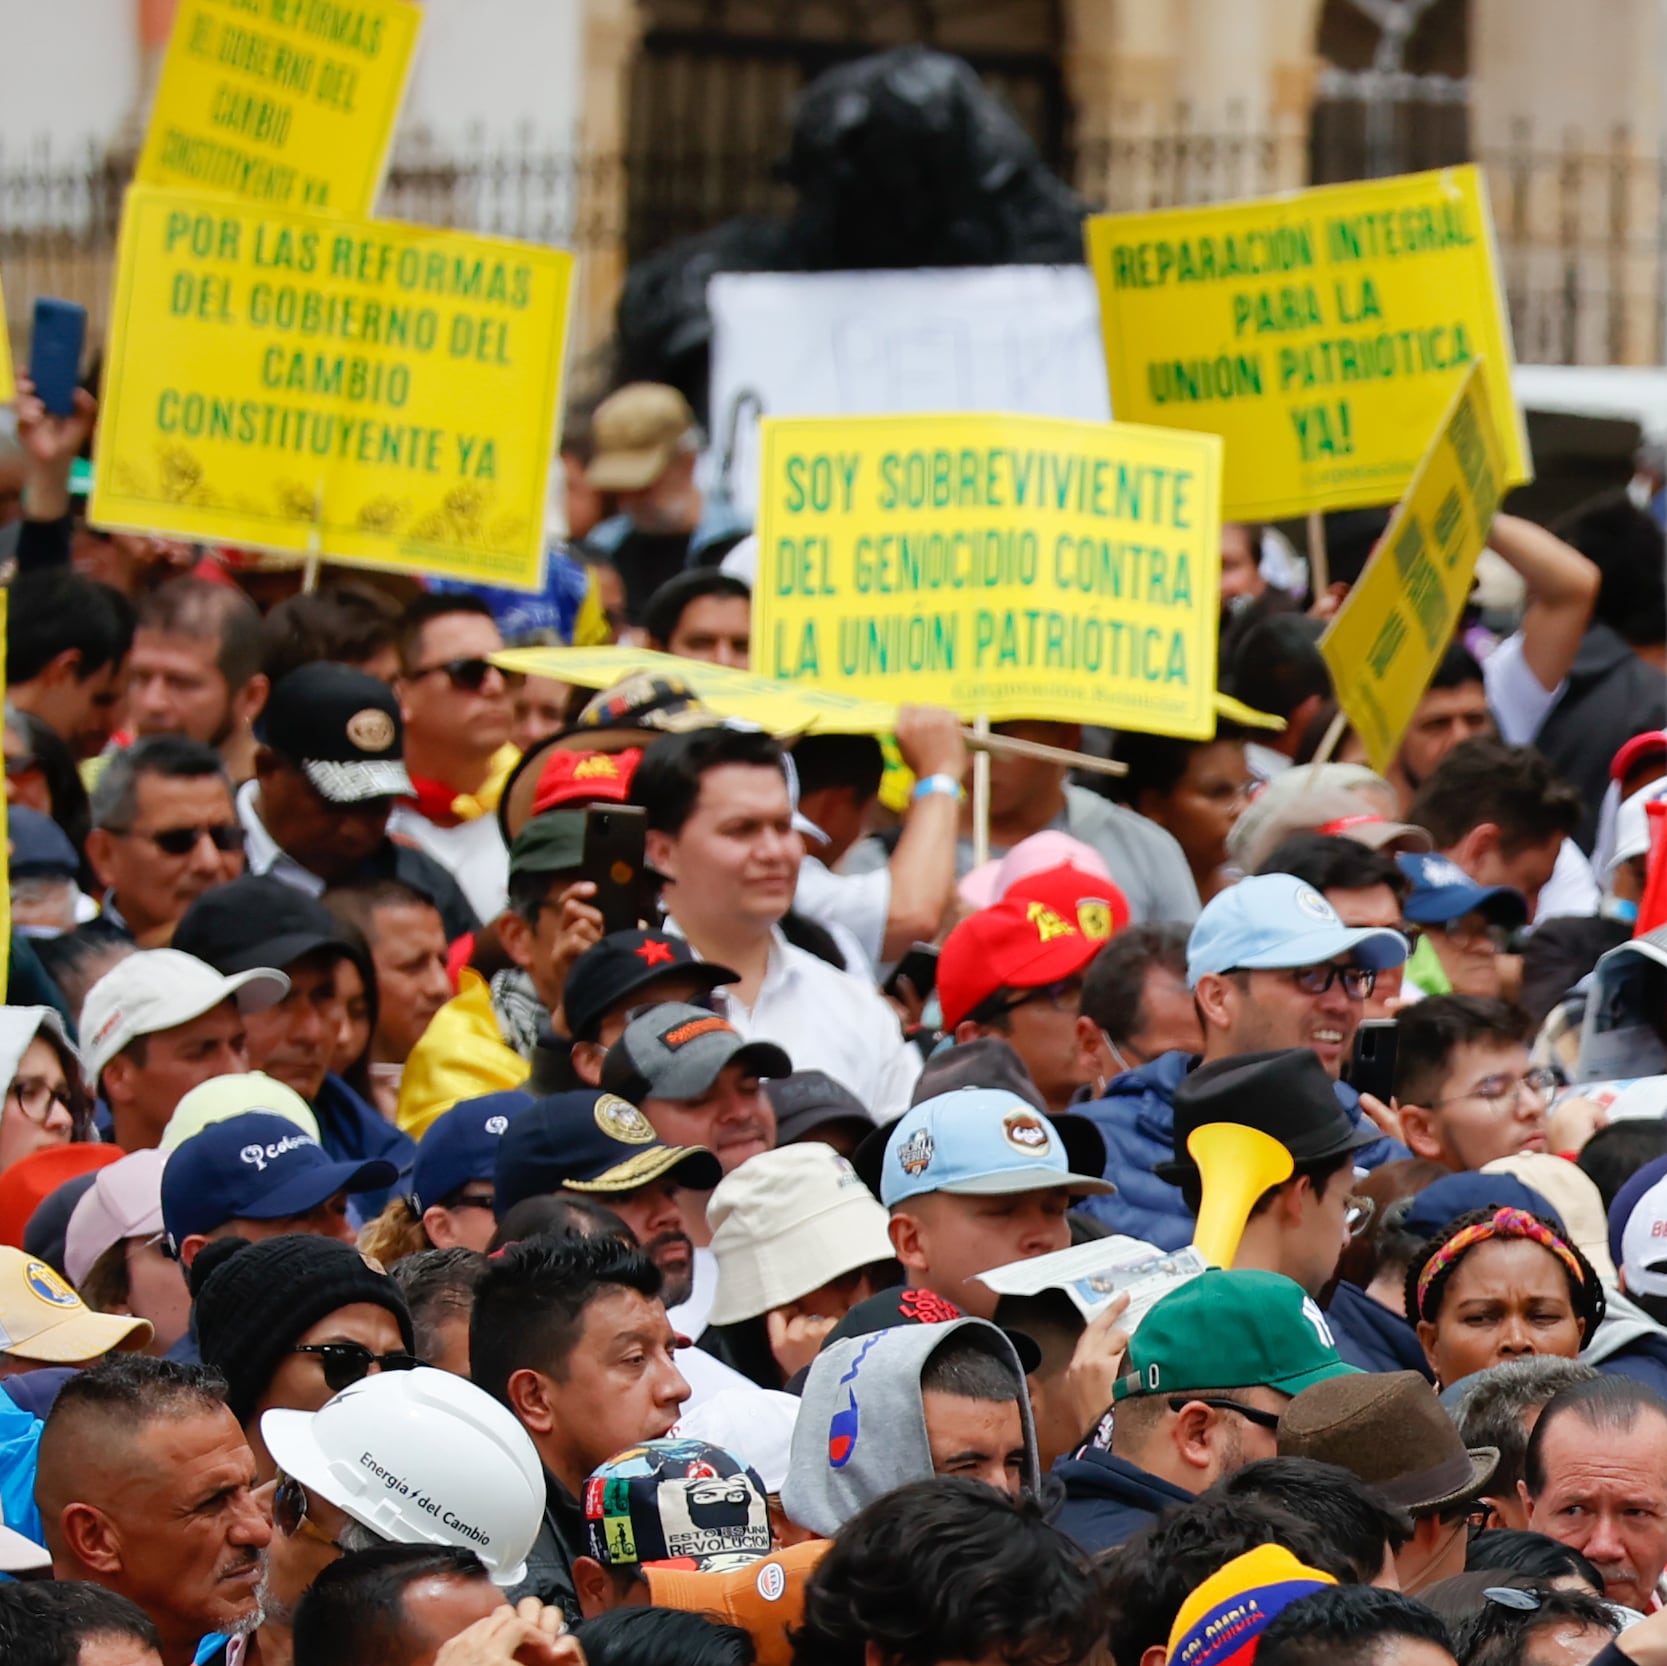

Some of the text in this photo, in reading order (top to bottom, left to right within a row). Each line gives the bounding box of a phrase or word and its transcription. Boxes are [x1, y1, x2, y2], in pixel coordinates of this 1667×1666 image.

[164, 210, 532, 311] POR LAS REFORMAS
[1325, 201, 1474, 264] INTEGRAL
[169, 271, 513, 367] DEL GOBIERNO DEL
[1232, 275, 1385, 339] PARA LA
[261, 343, 412, 411] CAMBIO
[1148, 342, 1264, 405] UNIÓN
[155, 387, 498, 482] CONSTITUYENTE YA
[1290, 401, 1355, 464] YA!
[784, 446, 1196, 531] SOY SOBREVIVIENTE
[775, 527, 1195, 610] DEL GENOCIDIO CONTRA
[774, 602, 1191, 687] LA UNIÓN PATRIÓTICA
[359, 1451, 492, 1548] Energía del Cambio
[669, 1524, 767, 1544] ESTO ES UNA
[668, 1533, 769, 1559] REVOLUCION
